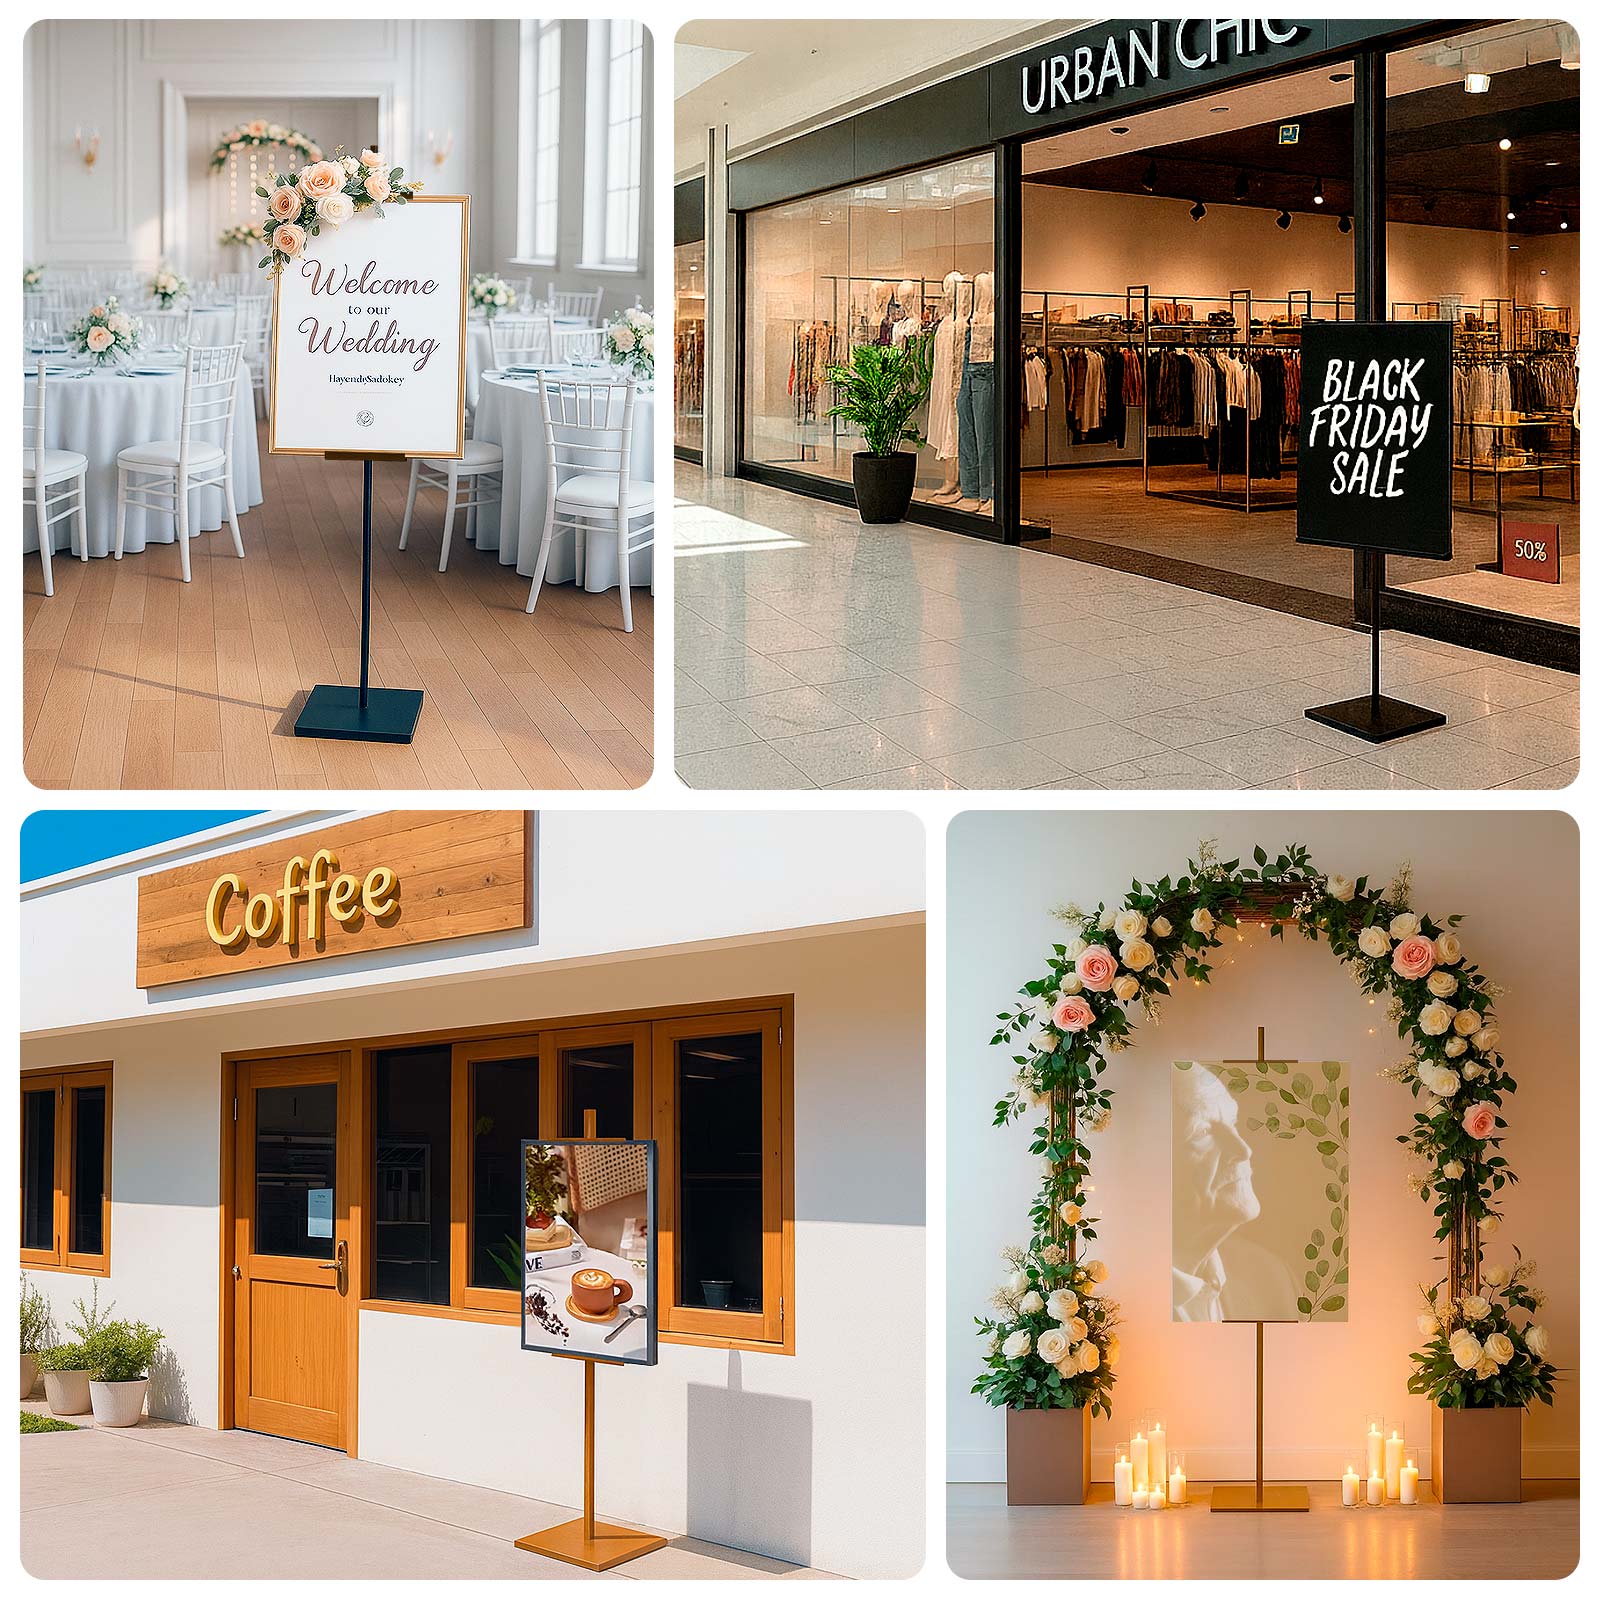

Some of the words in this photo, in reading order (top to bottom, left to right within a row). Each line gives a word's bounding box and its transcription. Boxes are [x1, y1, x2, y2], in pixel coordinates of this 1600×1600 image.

[1021, 20, 1159, 115] URBAN
[301, 259, 440, 296] Welcome
[348, 305, 362, 316] to
[366, 306, 391, 316] our
[298, 316, 441, 372] Wedding
[1322, 357, 1426, 403] BLACK
[1308, 402, 1434, 450] FRIDAY
[1329, 448, 1410, 498] SALE
[1515, 539, 1547, 562] 50%
[205, 848, 400, 946] Coffee
[525, 1256, 543, 1271] VE
